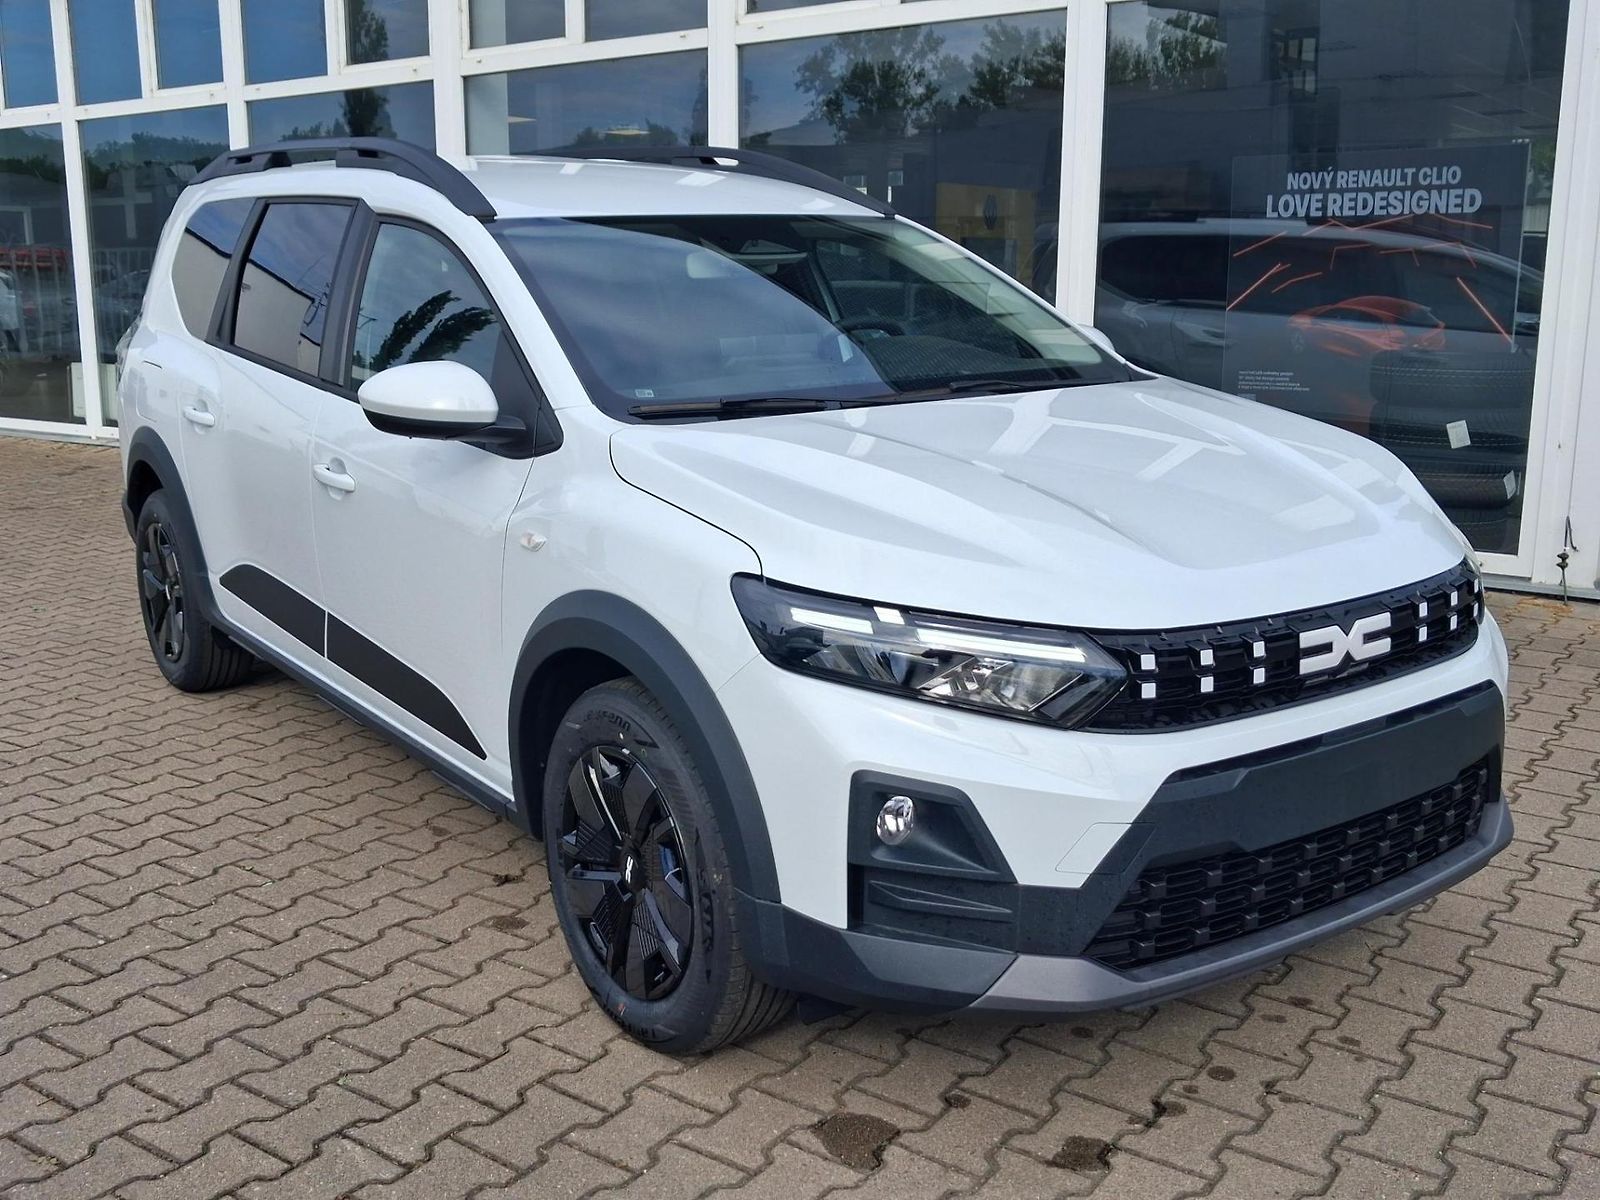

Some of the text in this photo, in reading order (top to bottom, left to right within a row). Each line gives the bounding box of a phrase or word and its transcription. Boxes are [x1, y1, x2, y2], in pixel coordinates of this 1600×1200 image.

[1286, 165, 1462, 190] NOVÝ RENAULT CLIO
[1266, 188, 1482, 218] LOVE REDESIGNED
